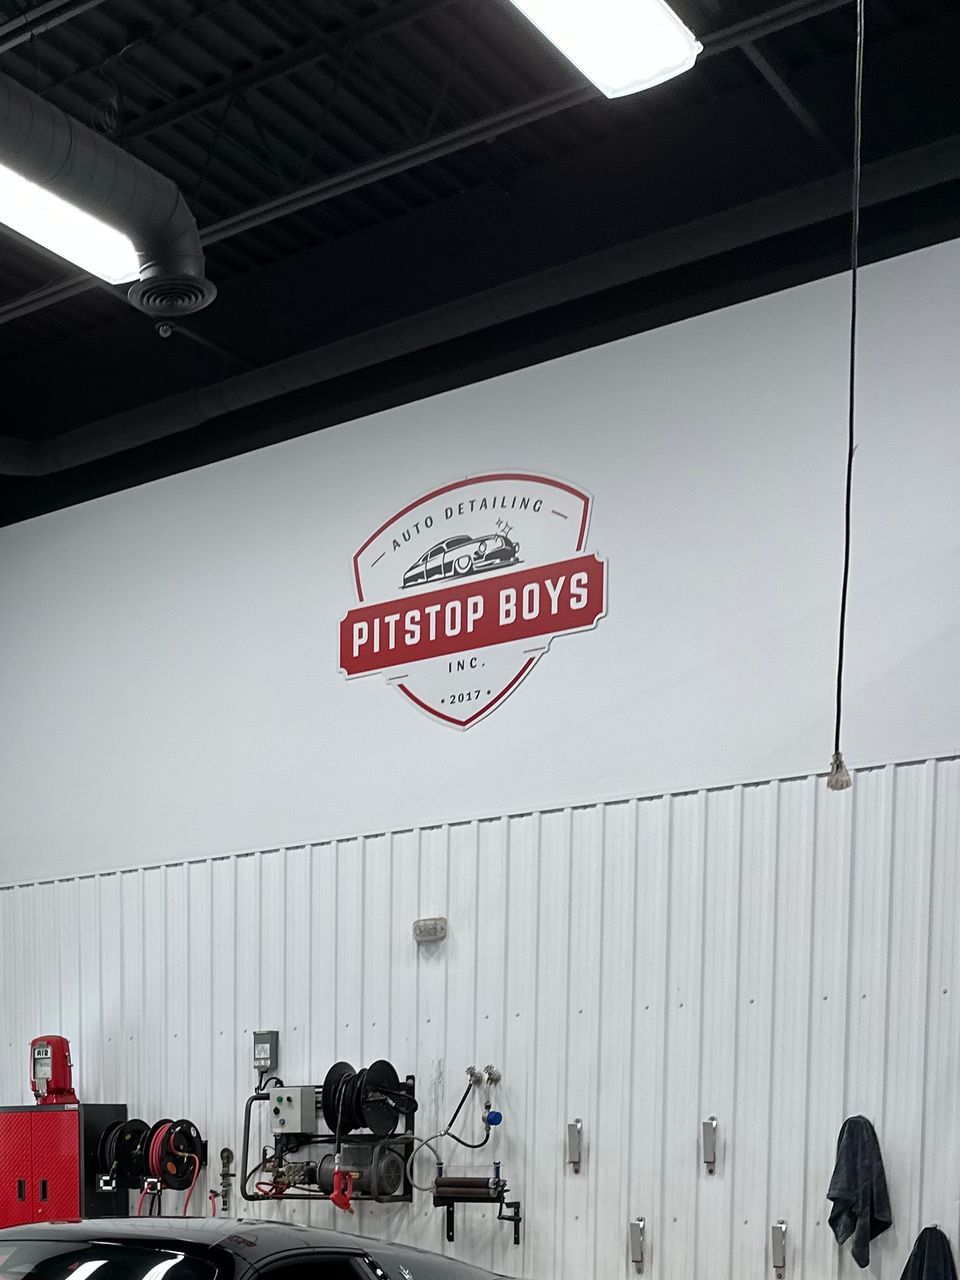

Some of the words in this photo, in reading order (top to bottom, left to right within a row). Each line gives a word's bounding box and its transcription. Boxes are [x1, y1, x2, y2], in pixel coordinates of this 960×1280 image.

[391, 516, 435, 551] AUTO
[444, 496, 543, 521] DETAILING
[352, 595, 485, 658] PITSTOP
[499, 571, 589, 626] BOYS
[448, 656, 486, 674] INC.
[449, 689, 481, 705] 2017
[36, 1049, 49, 1057] AIR
